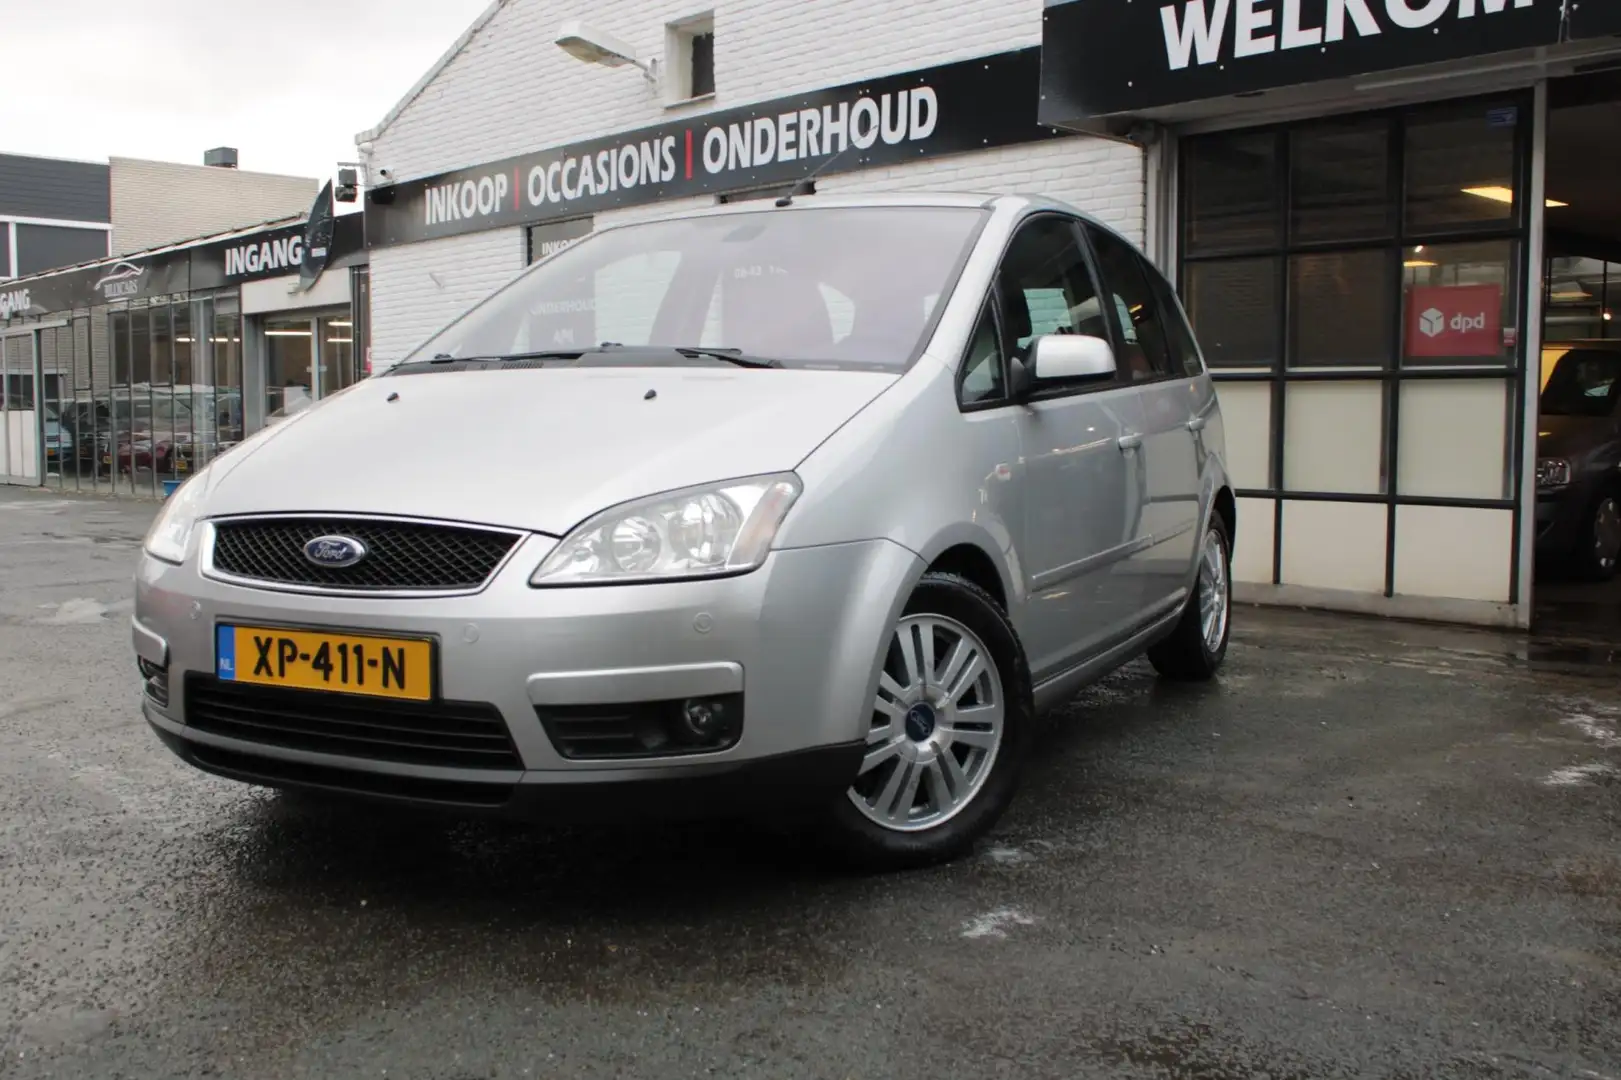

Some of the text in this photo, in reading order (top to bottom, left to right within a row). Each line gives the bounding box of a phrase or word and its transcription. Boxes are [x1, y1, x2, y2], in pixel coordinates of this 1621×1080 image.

[1159, 0, 1535, 71] WELK
[425, 86, 938, 225] INKOOP OCCASIONS ONDERHOUD
[225, 235, 303, 276] INGANG
[1450, 312, 1485, 333] dpd
[314, 541, 347, 560] Ford
[220, 657, 234, 671] NL
[253, 636, 405, 690] XP-411-N
